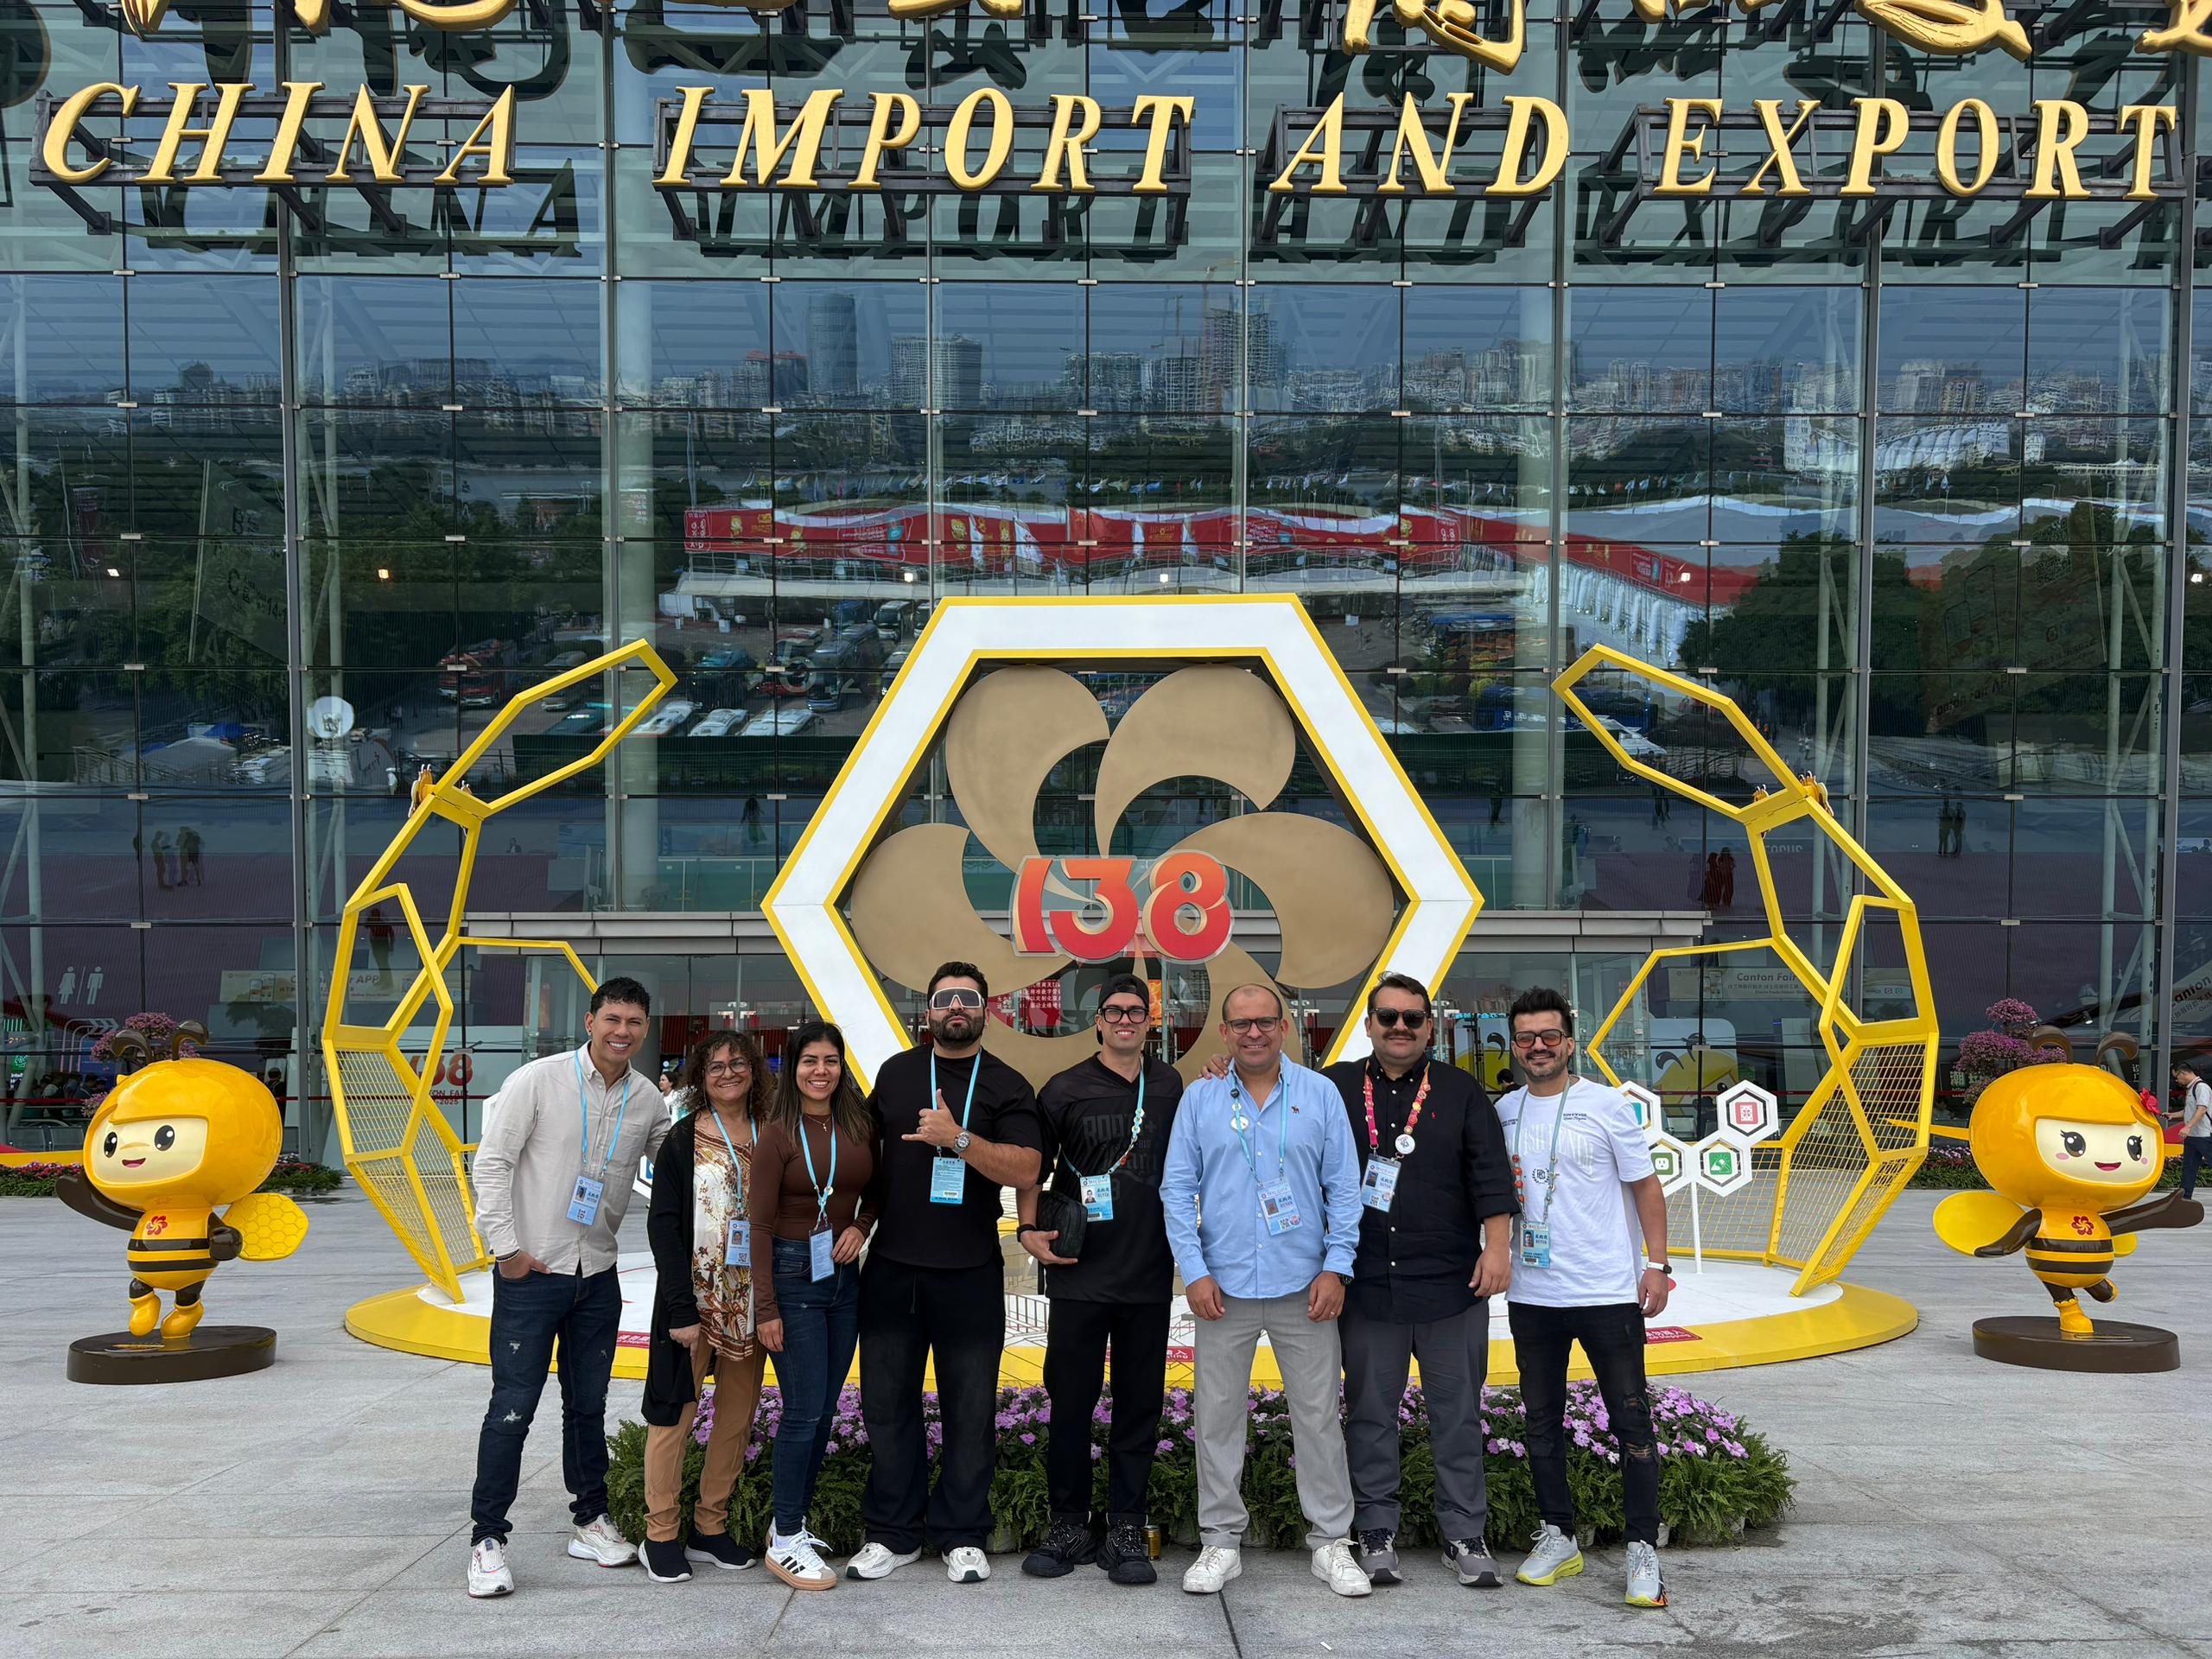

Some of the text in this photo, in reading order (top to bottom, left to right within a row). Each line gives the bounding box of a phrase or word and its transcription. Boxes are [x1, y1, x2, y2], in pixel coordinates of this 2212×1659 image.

[43, 82, 2177, 200] CHINA IMPORT AND EXPORT
[1011, 852, 1232, 961] 138
[1736, 972, 1774, 982] Canton
[2171, 976, 2212, 1007] anton
